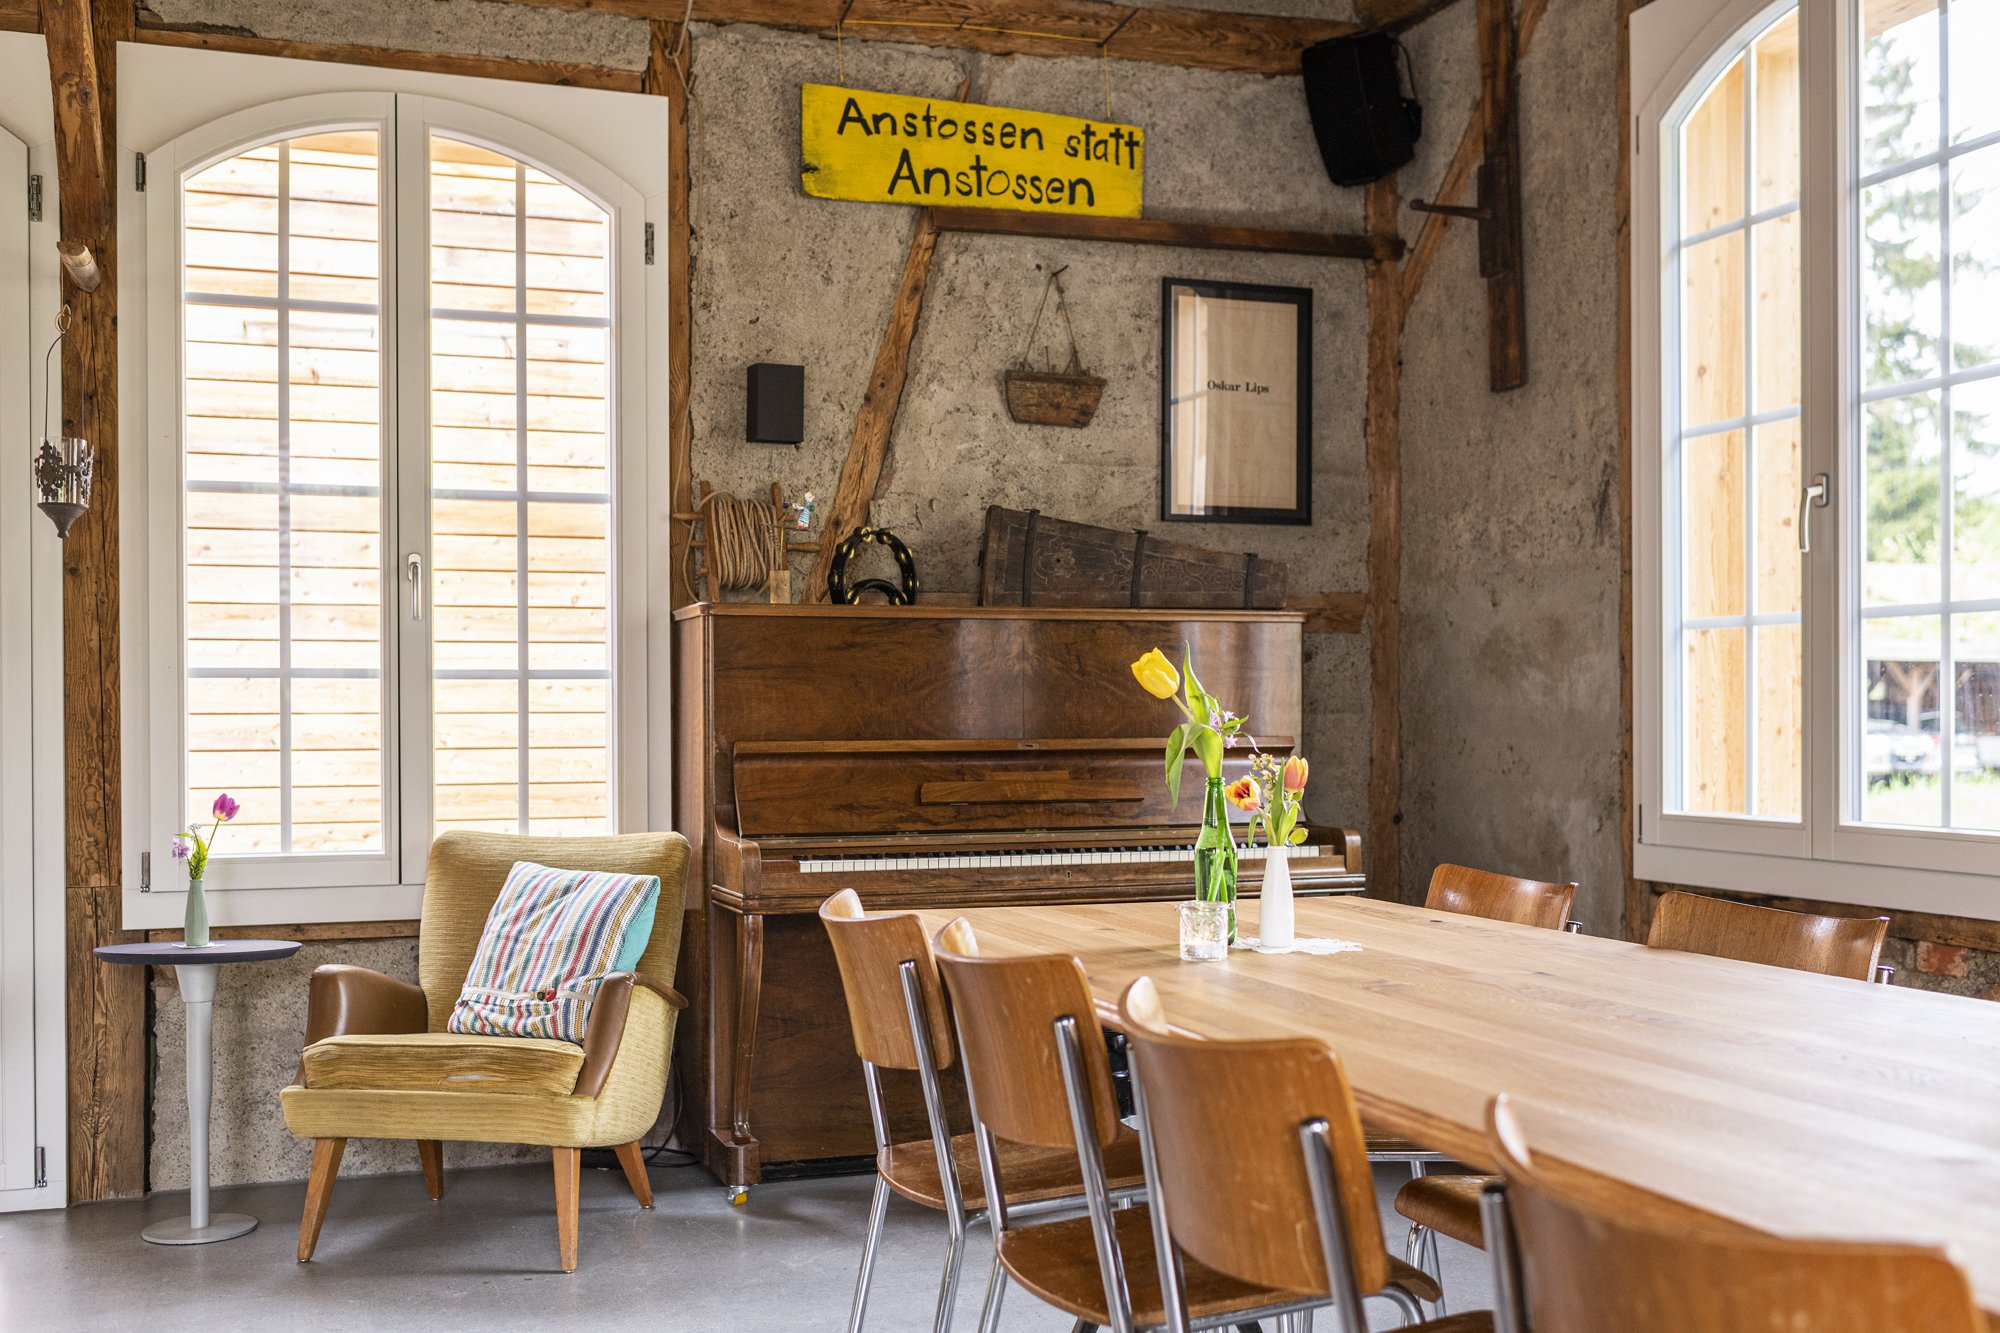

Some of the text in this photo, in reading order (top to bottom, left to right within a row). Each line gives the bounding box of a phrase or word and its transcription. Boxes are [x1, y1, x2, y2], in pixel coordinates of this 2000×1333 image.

[836, 97, 1140, 170] Anstossen statt
[887, 148, 1095, 207] Anstossen
[1207, 379, 1270, 395] Oskar Lips
